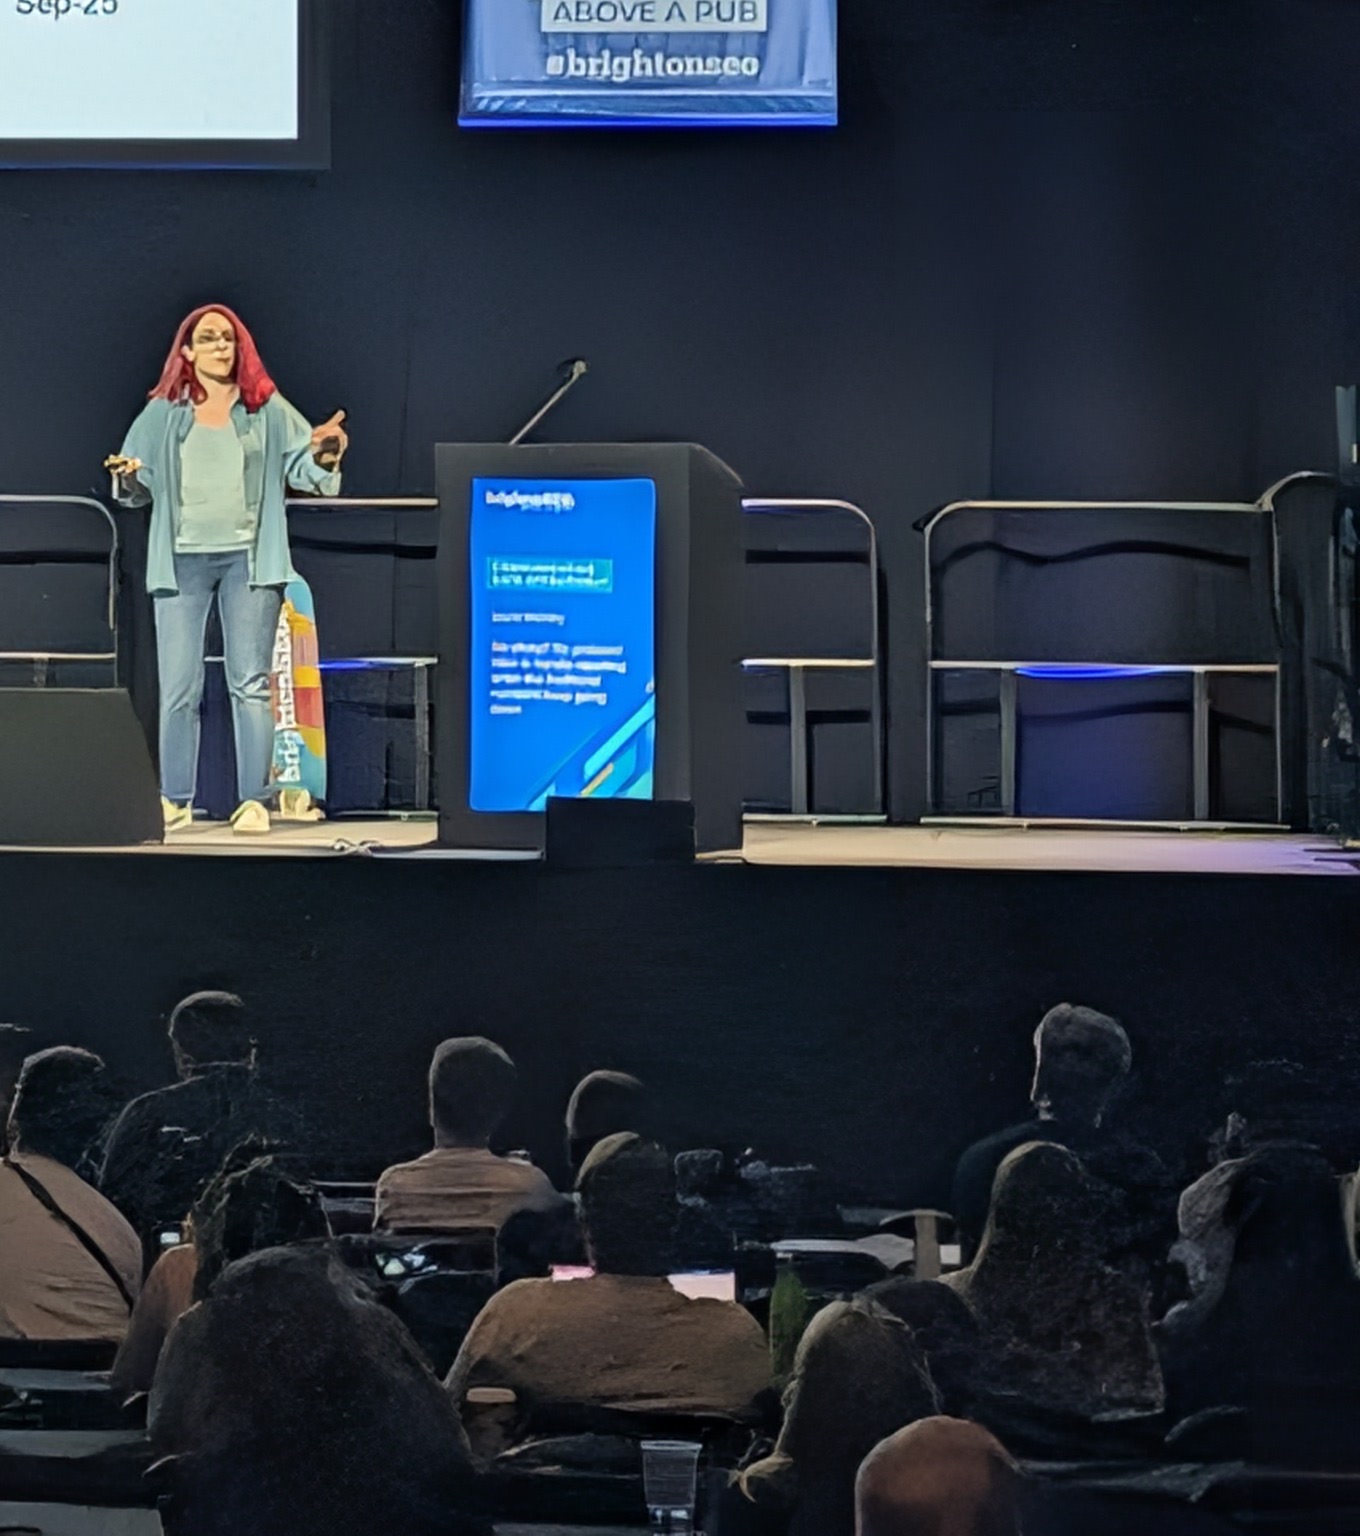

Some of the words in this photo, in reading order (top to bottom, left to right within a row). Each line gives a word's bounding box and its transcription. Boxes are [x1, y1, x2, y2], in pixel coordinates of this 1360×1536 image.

[553, 0, 656, 24] ABOVE
[665, 1, 686, 24] A
[695, 0, 758, 24] PUB
